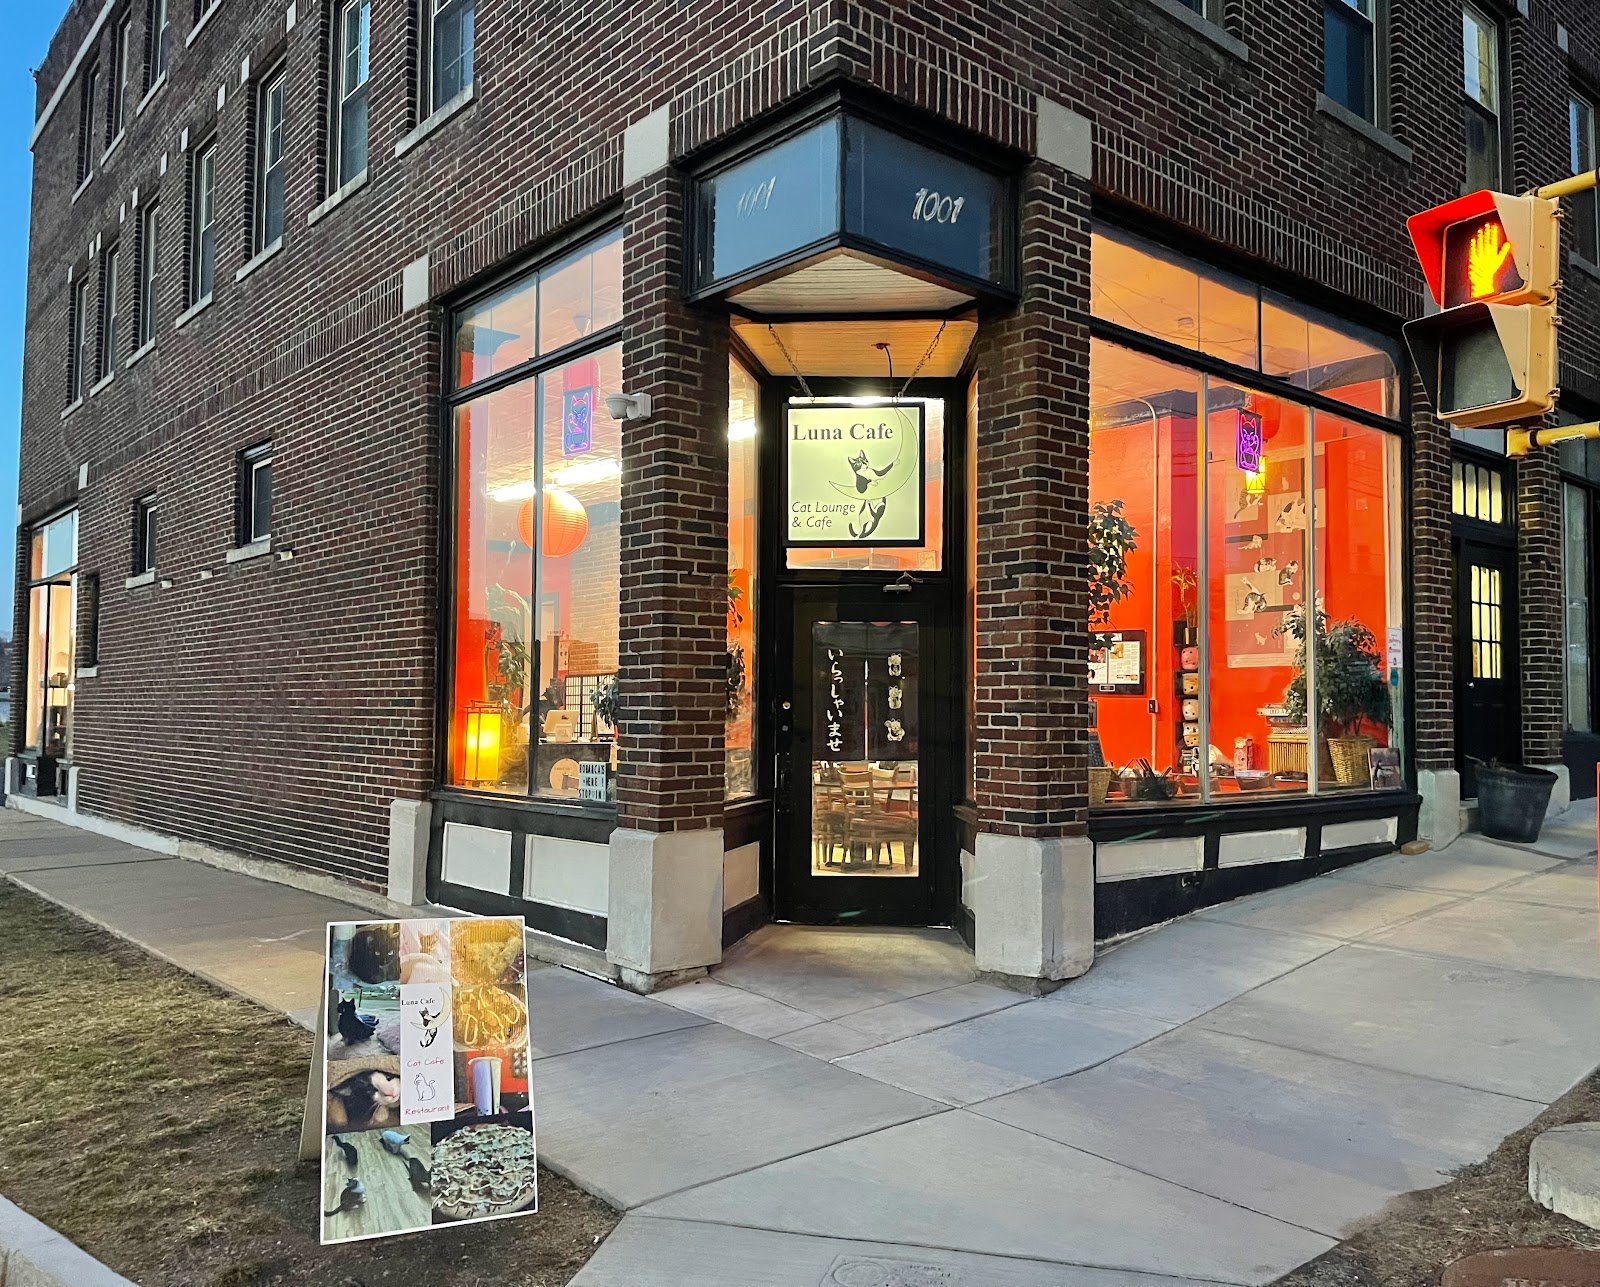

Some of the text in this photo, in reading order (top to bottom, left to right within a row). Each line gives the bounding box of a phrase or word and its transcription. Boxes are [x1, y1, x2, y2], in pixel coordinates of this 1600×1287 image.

[912, 187, 965, 224] 1001
[791, 423, 894, 441] Luna Cafe
[791, 501, 856, 516] Cat Lounge
[791, 516, 833, 530] & Cafe
[826, 649, 845, 752] いらっしゃいませ
[406, 1057, 445, 1068] Cat Cafe
[405, 1105, 450, 1116] Restaurant
